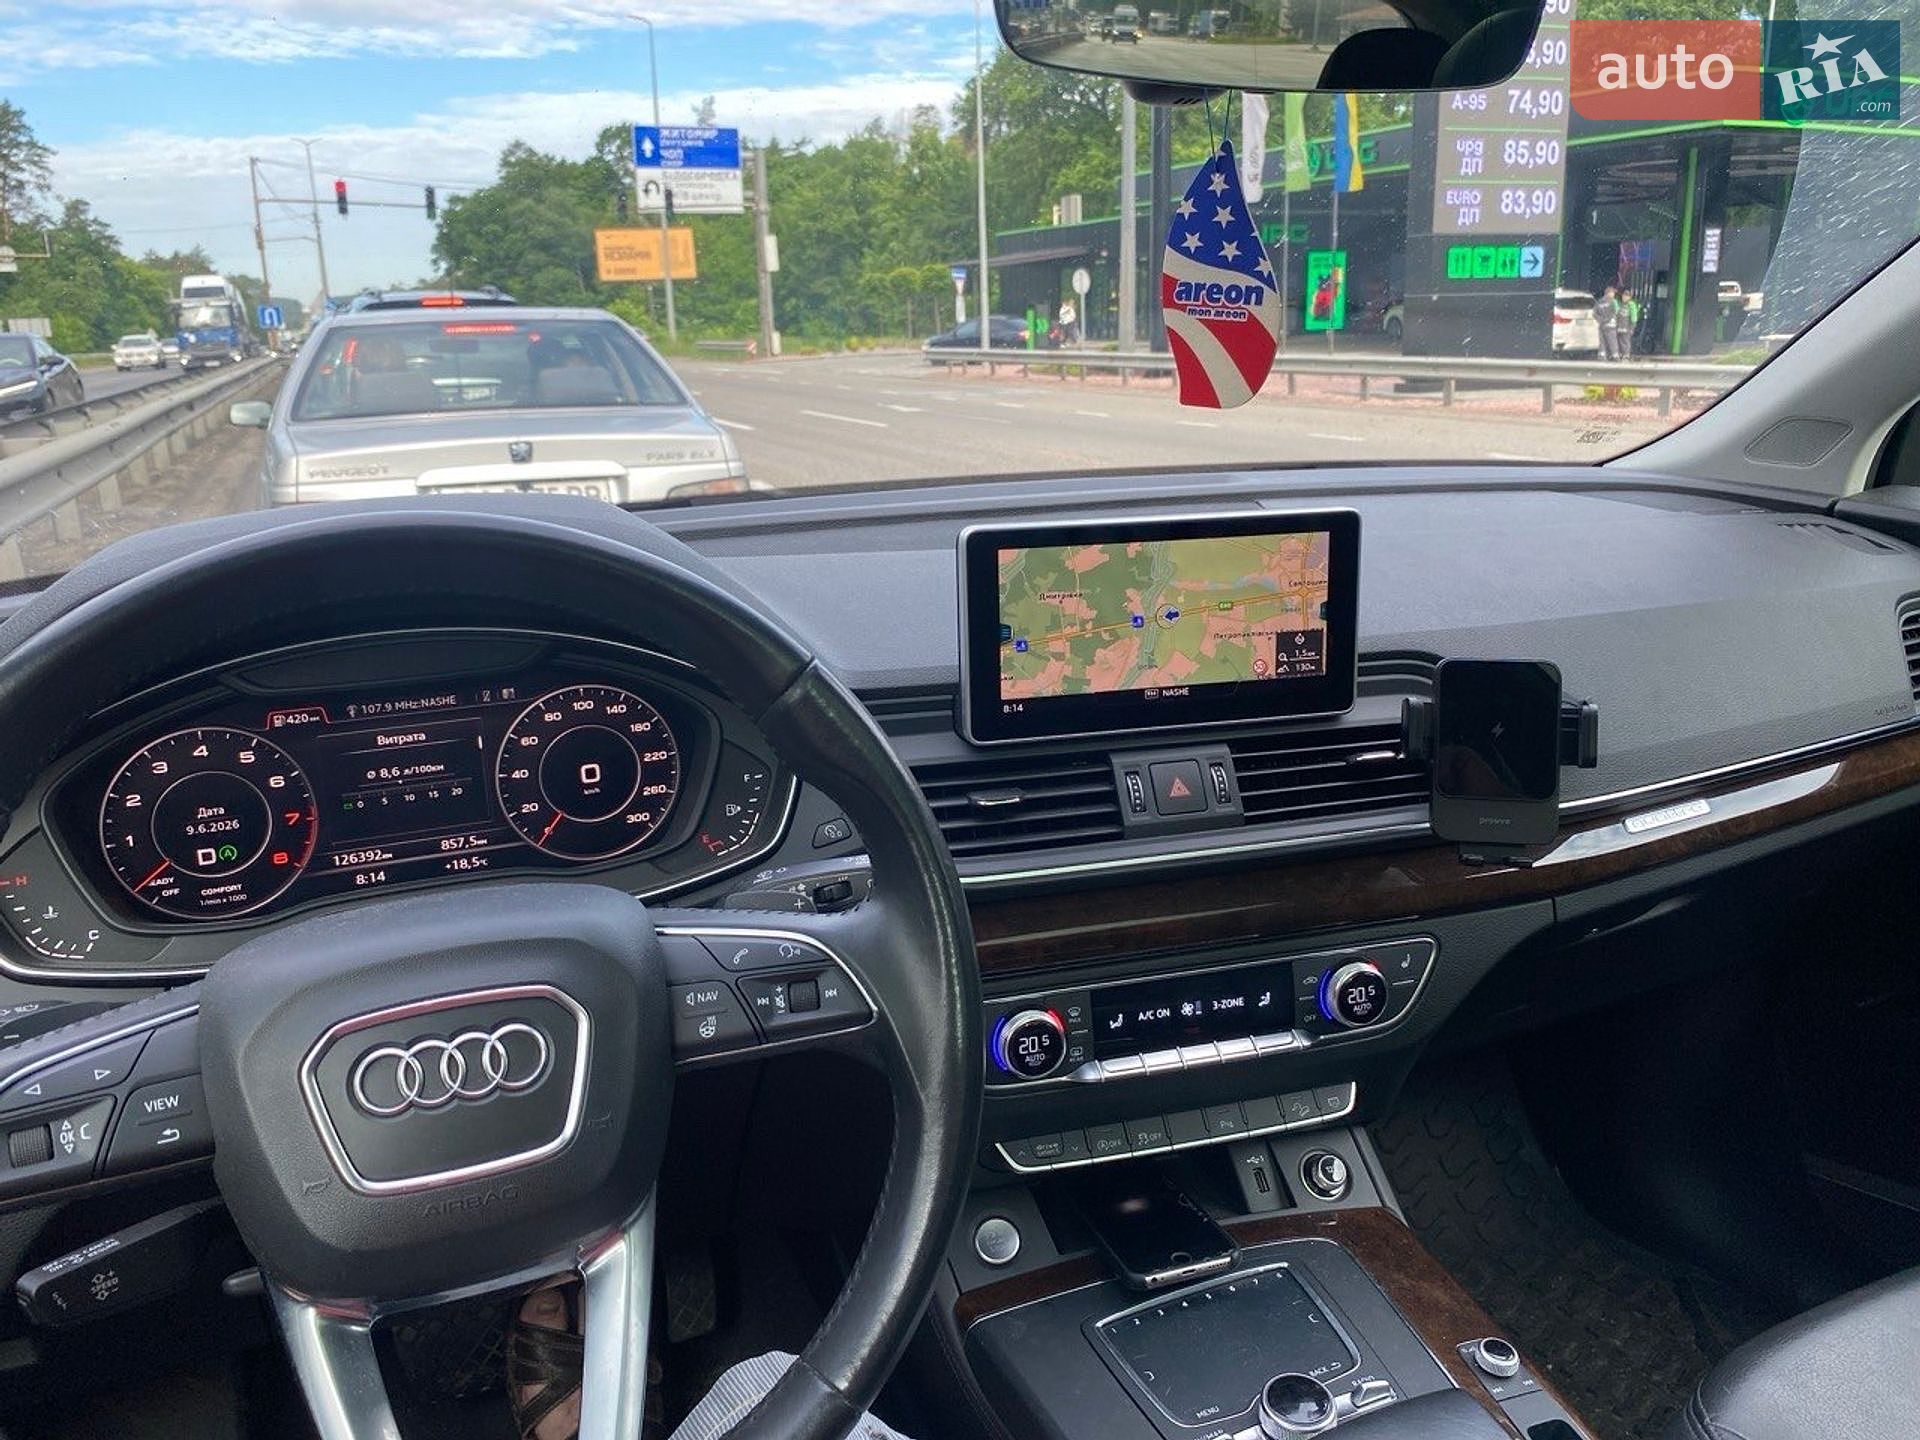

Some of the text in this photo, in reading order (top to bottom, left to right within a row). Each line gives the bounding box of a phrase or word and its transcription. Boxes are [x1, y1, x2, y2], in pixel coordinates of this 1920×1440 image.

[1507, 89, 1563, 119] 74,90
[1503, 139, 1560, 169] 85,90
[1461, 157, 1482, 176] ДП
[1446, 190, 1481, 205] EURO
[1501, 189, 1556, 219] 83,90
[1458, 207, 1480, 226] ДП
[1174, 281, 1264, 306] areon
[1187, 307, 1247, 319] mon areon
[1162, 687, 1190, 697] NASHE
[361, 701, 392, 715] 107.9
[573, 701, 594, 711] 100
[606, 704, 627, 714] 140
[1003, 704, 1024, 713] 8:14
[544, 712, 562, 722] 80
[630, 722, 651, 732] 180
[376, 732, 426, 746] Витрата
[520, 736, 538, 746] 60
[193, 745, 209, 757] 4
[240, 751, 255, 763] 5
[643, 751, 667, 761] 220
[152, 761, 168, 774] 3
[380, 767, 400, 779] 8,6
[511, 769, 529, 779] 40
[269, 776, 285, 788] 6
[428, 790, 439, 798] 15
[451, 787, 463, 796] 20
[642, 785, 667, 795] 260
[126, 794, 142, 807] 2
[382, 796, 389, 805] 5
[404, 793, 415, 801] 10
[357, 800, 364, 808] 0
[522, 803, 538, 813] 20
[198, 807, 225, 819] Дата
[285, 813, 300, 825] 7
[626, 813, 650, 824] 300
[186, 819, 240, 836] 9.6.2026
[126, 835, 135, 847] 1
[273, 852, 288, 864] 8
[356, 871, 386, 885] 8:14
[162, 888, 180, 896] OFF
[201, 884, 242, 896] COMFORT
[697, 991, 719, 1002] NAV
[1212, 996, 1245, 1010] 3-ZONE
[1353, 1002, 1372, 1012] AUTO
[1138, 1007, 1170, 1021] A/C ON
[1025, 1053, 1045, 1063] AUTO
[143, 1095, 179, 1113] VIEW
[59, 1131, 75, 1144] OK
[424, 1184, 520, 1218] AIRBAG
